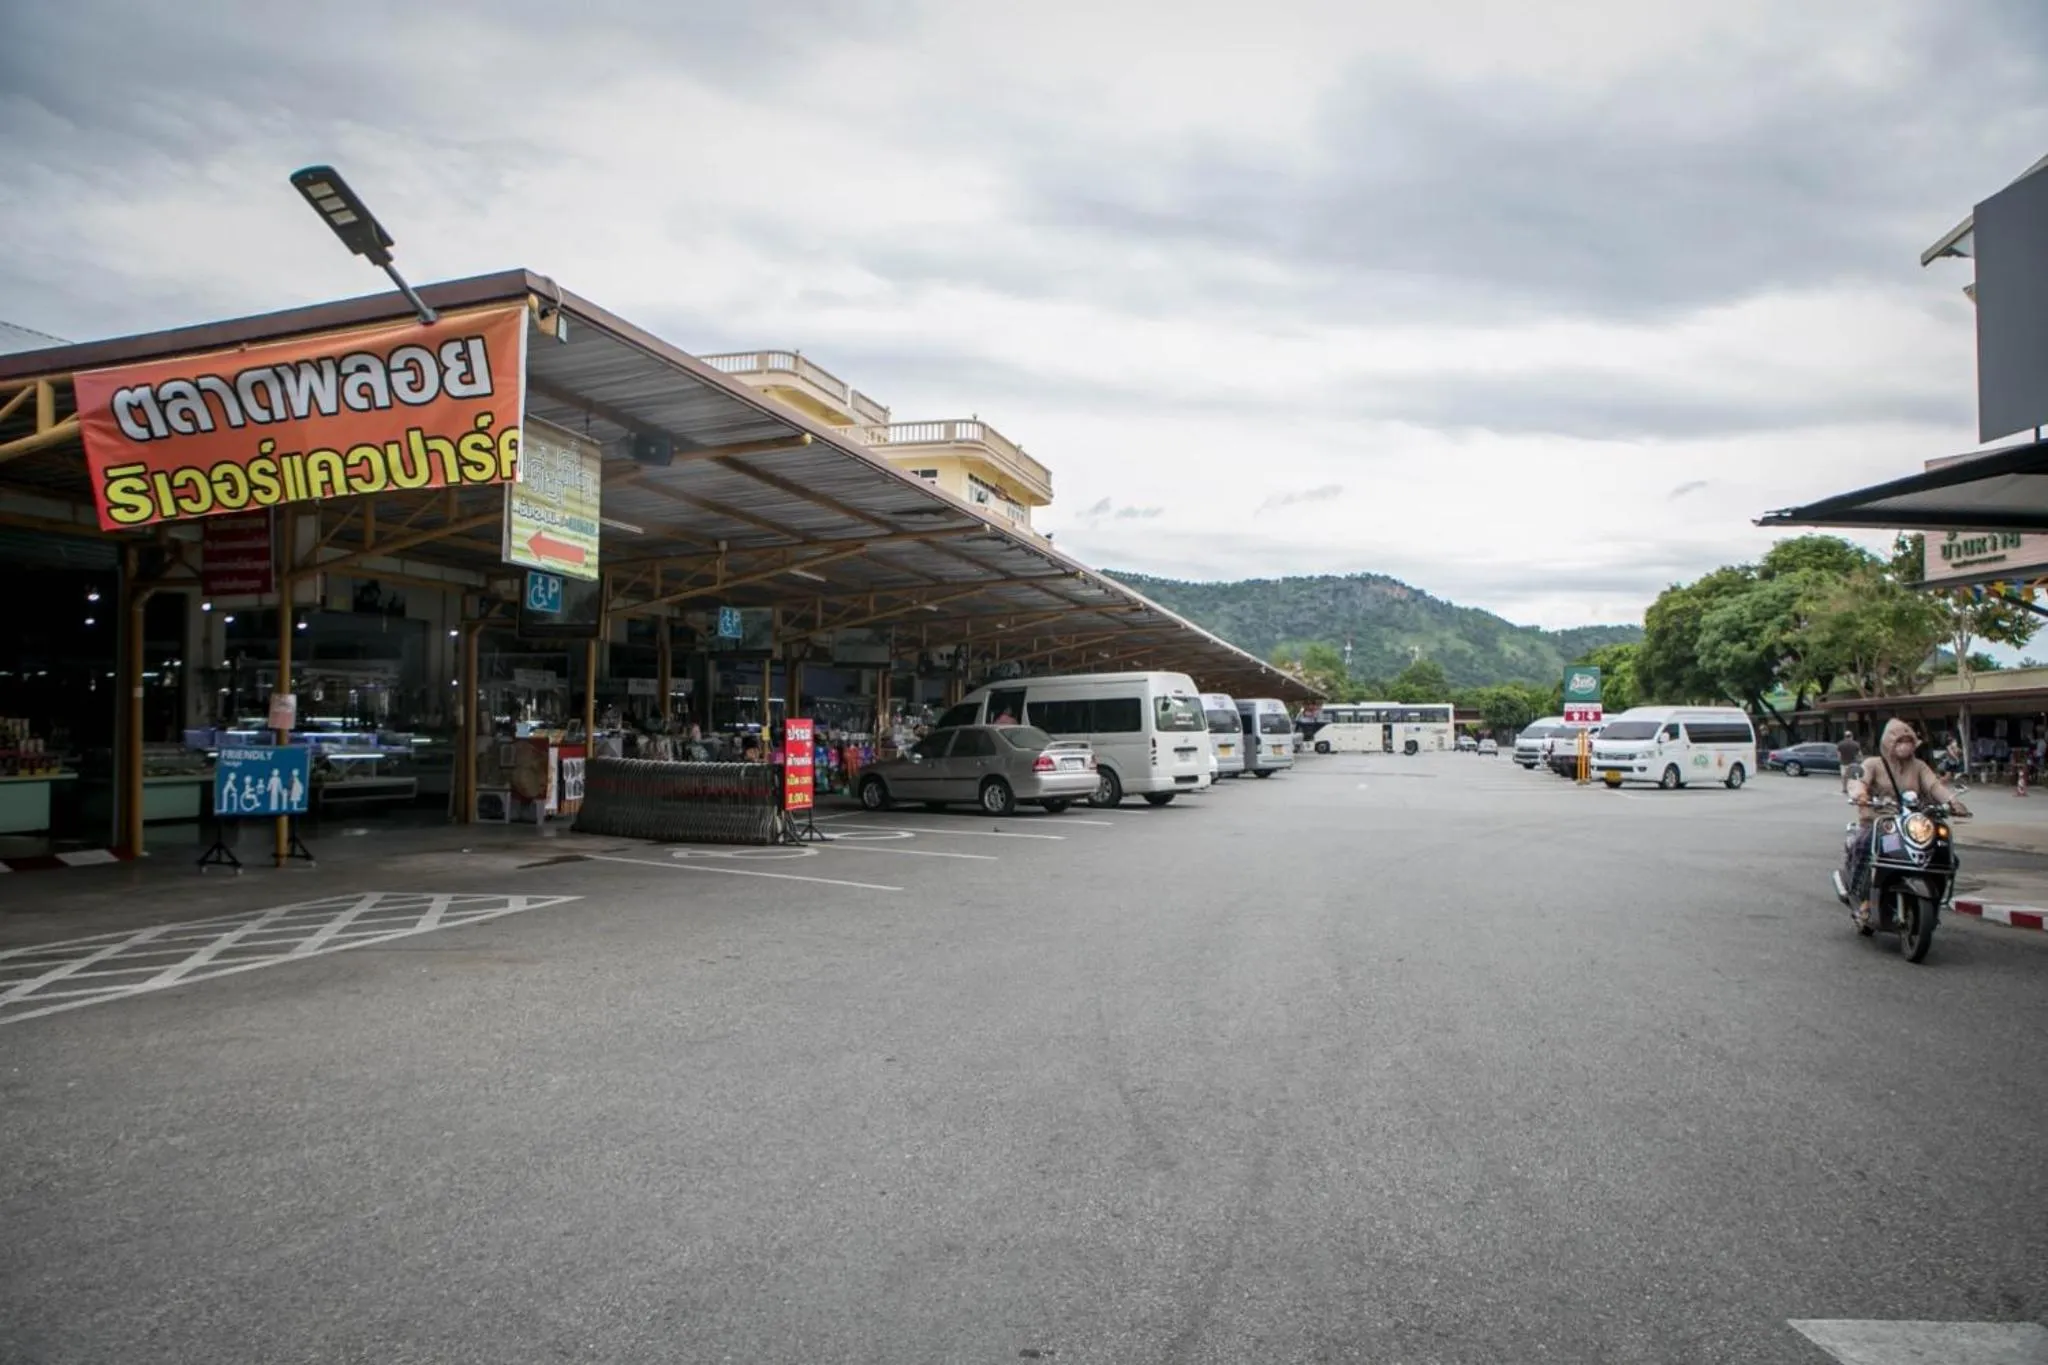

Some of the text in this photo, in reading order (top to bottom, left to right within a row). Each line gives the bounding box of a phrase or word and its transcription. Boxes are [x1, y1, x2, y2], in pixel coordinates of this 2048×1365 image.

[112, 336, 494, 441] ตลาดพลอย
[548, 579, 559, 600] P
[221, 749, 274, 761] FRIENDLY
